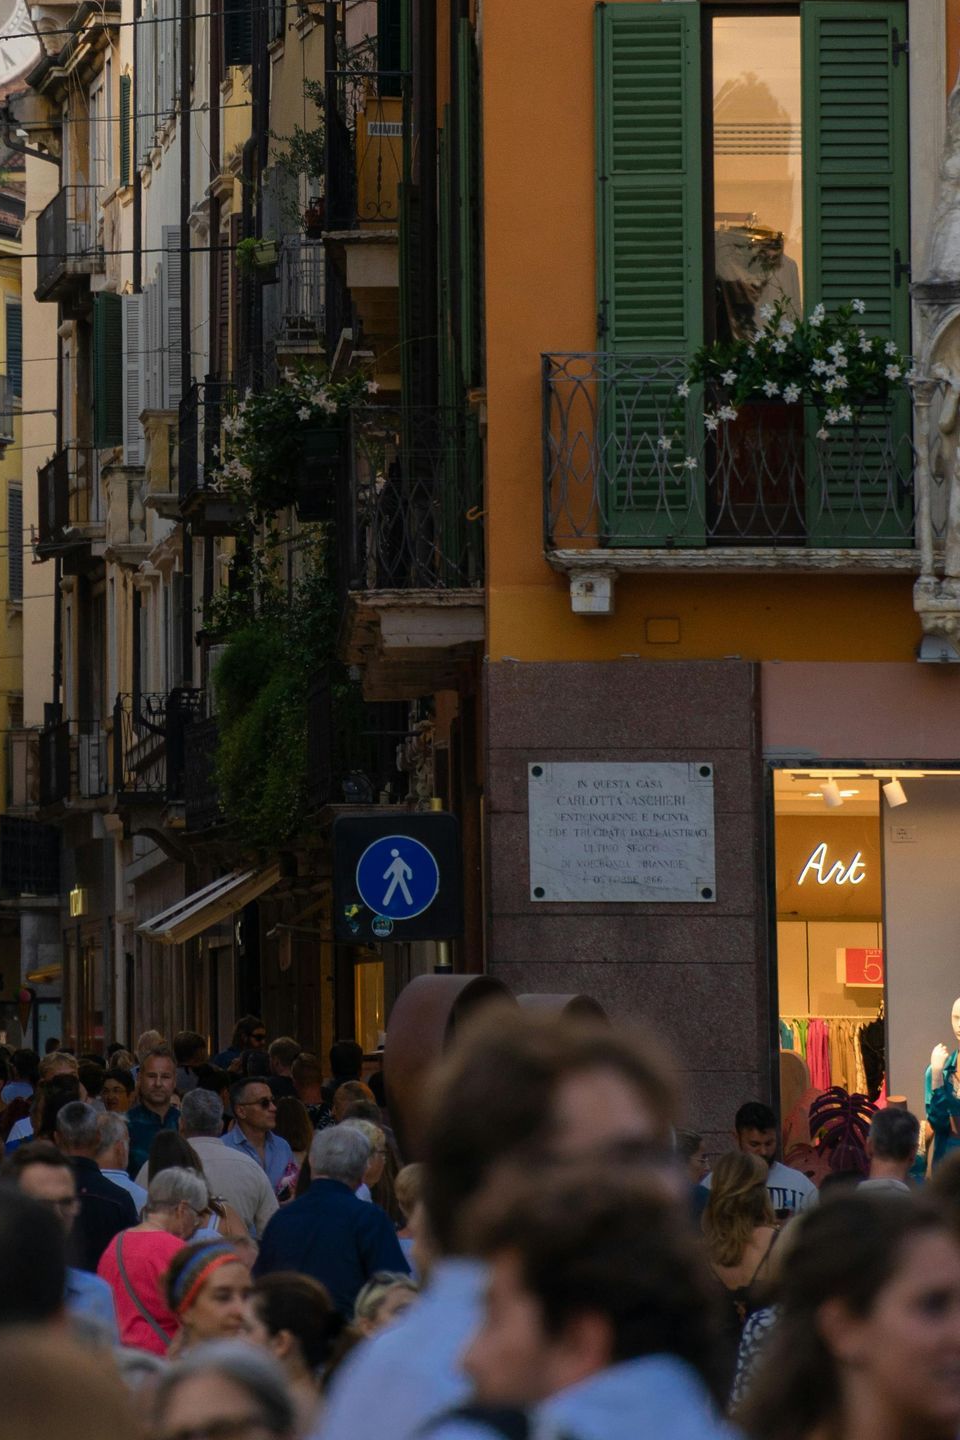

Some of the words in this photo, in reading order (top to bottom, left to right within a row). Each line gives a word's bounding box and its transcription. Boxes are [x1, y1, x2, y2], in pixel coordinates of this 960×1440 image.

[577, 780, 588, 789] IN
[593, 780, 630, 790] QUESTA
[636, 780, 663, 789] CASA
[556, 795, 623, 806] CARLOTTA
[631, 795, 686, 806] ASCHIERI
[797, 842, 866, 886] Art
